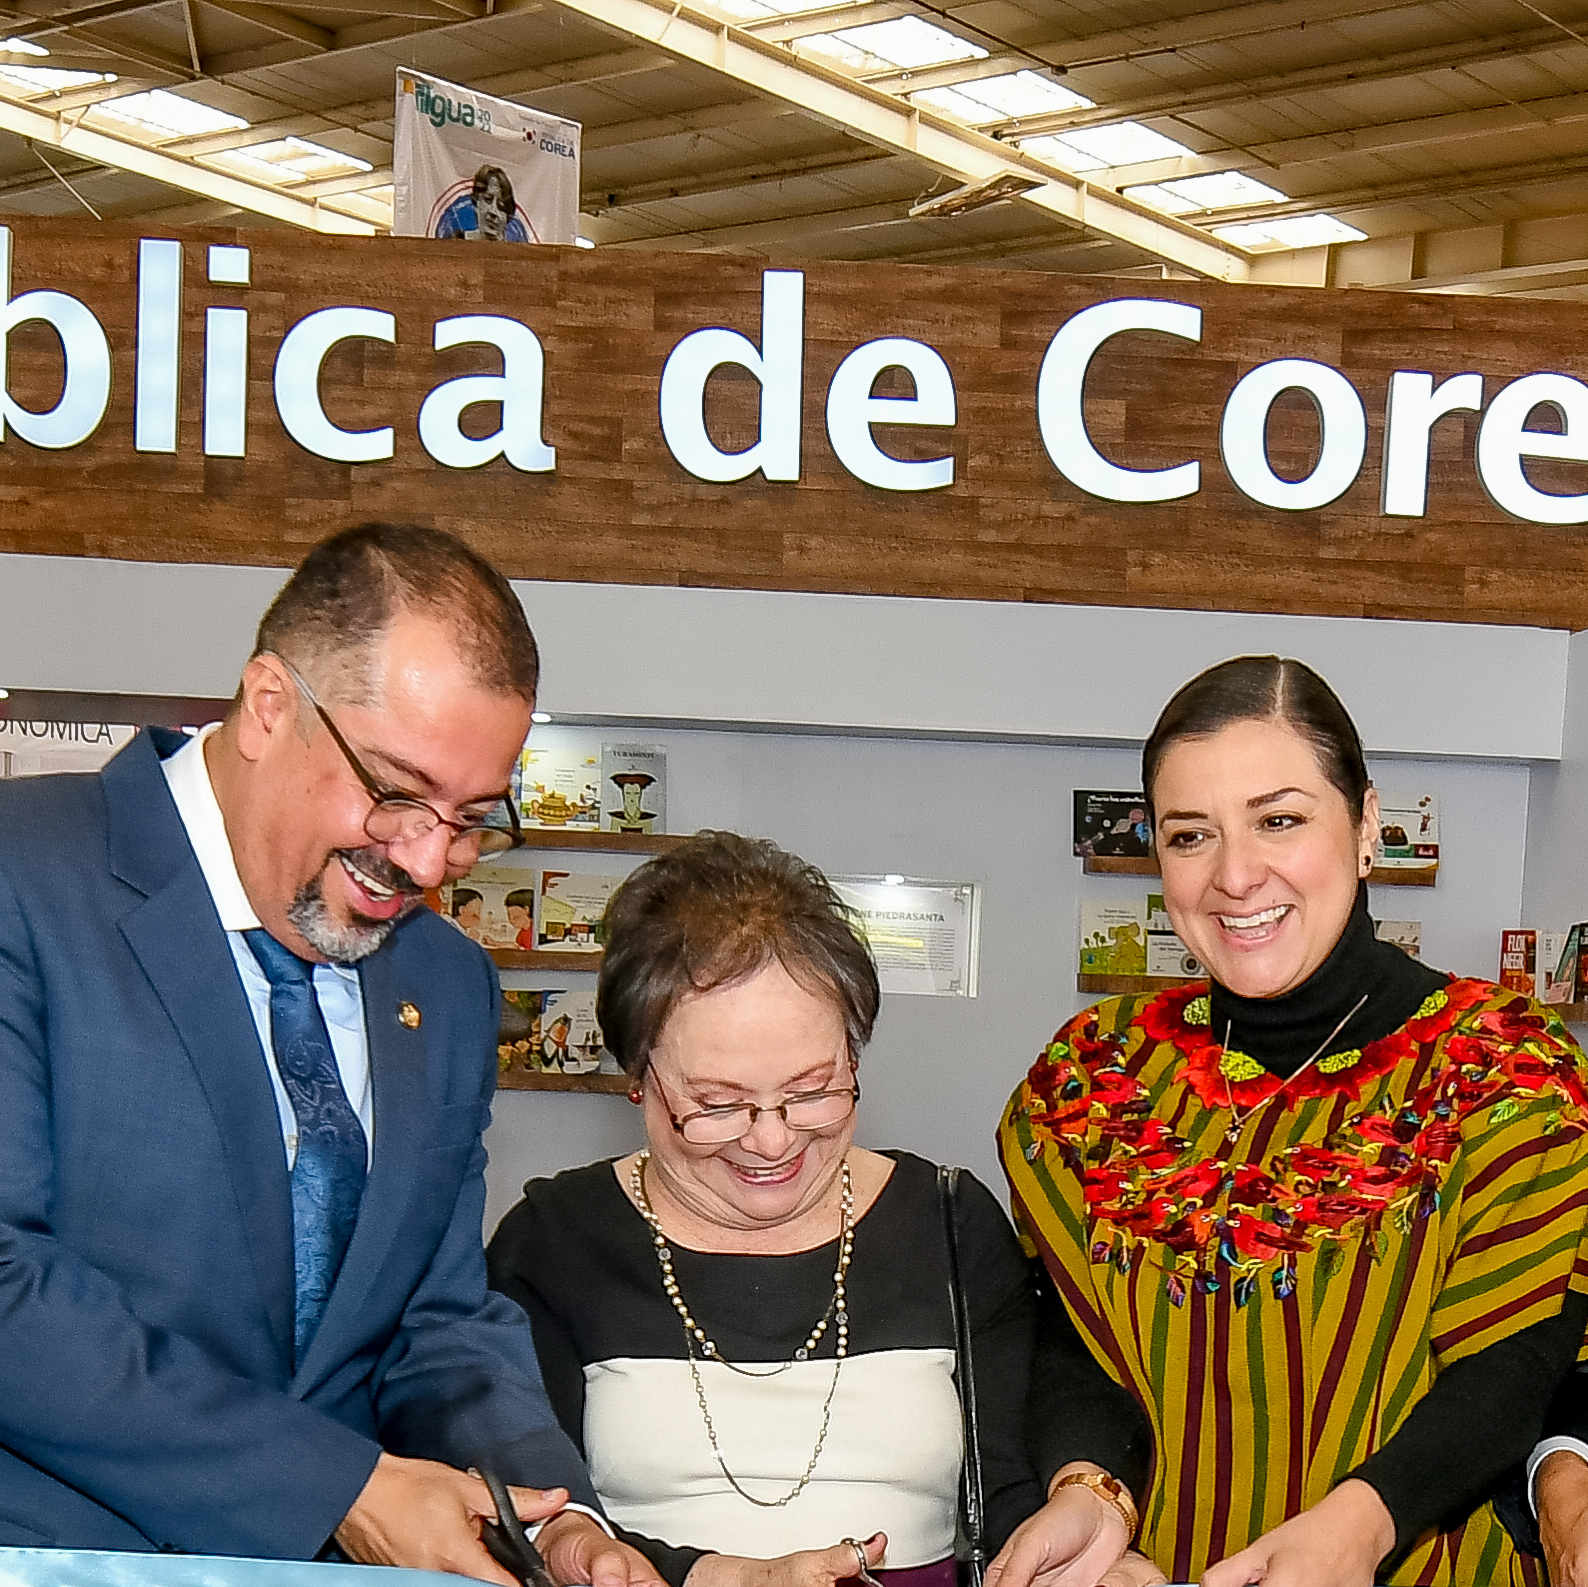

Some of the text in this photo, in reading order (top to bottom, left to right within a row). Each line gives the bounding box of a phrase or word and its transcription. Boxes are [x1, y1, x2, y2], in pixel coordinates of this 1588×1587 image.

[539, 138, 576, 160] COREA
[658, 267, 957, 492] de
[875, 910, 946, 923] PIEDRASANTA
